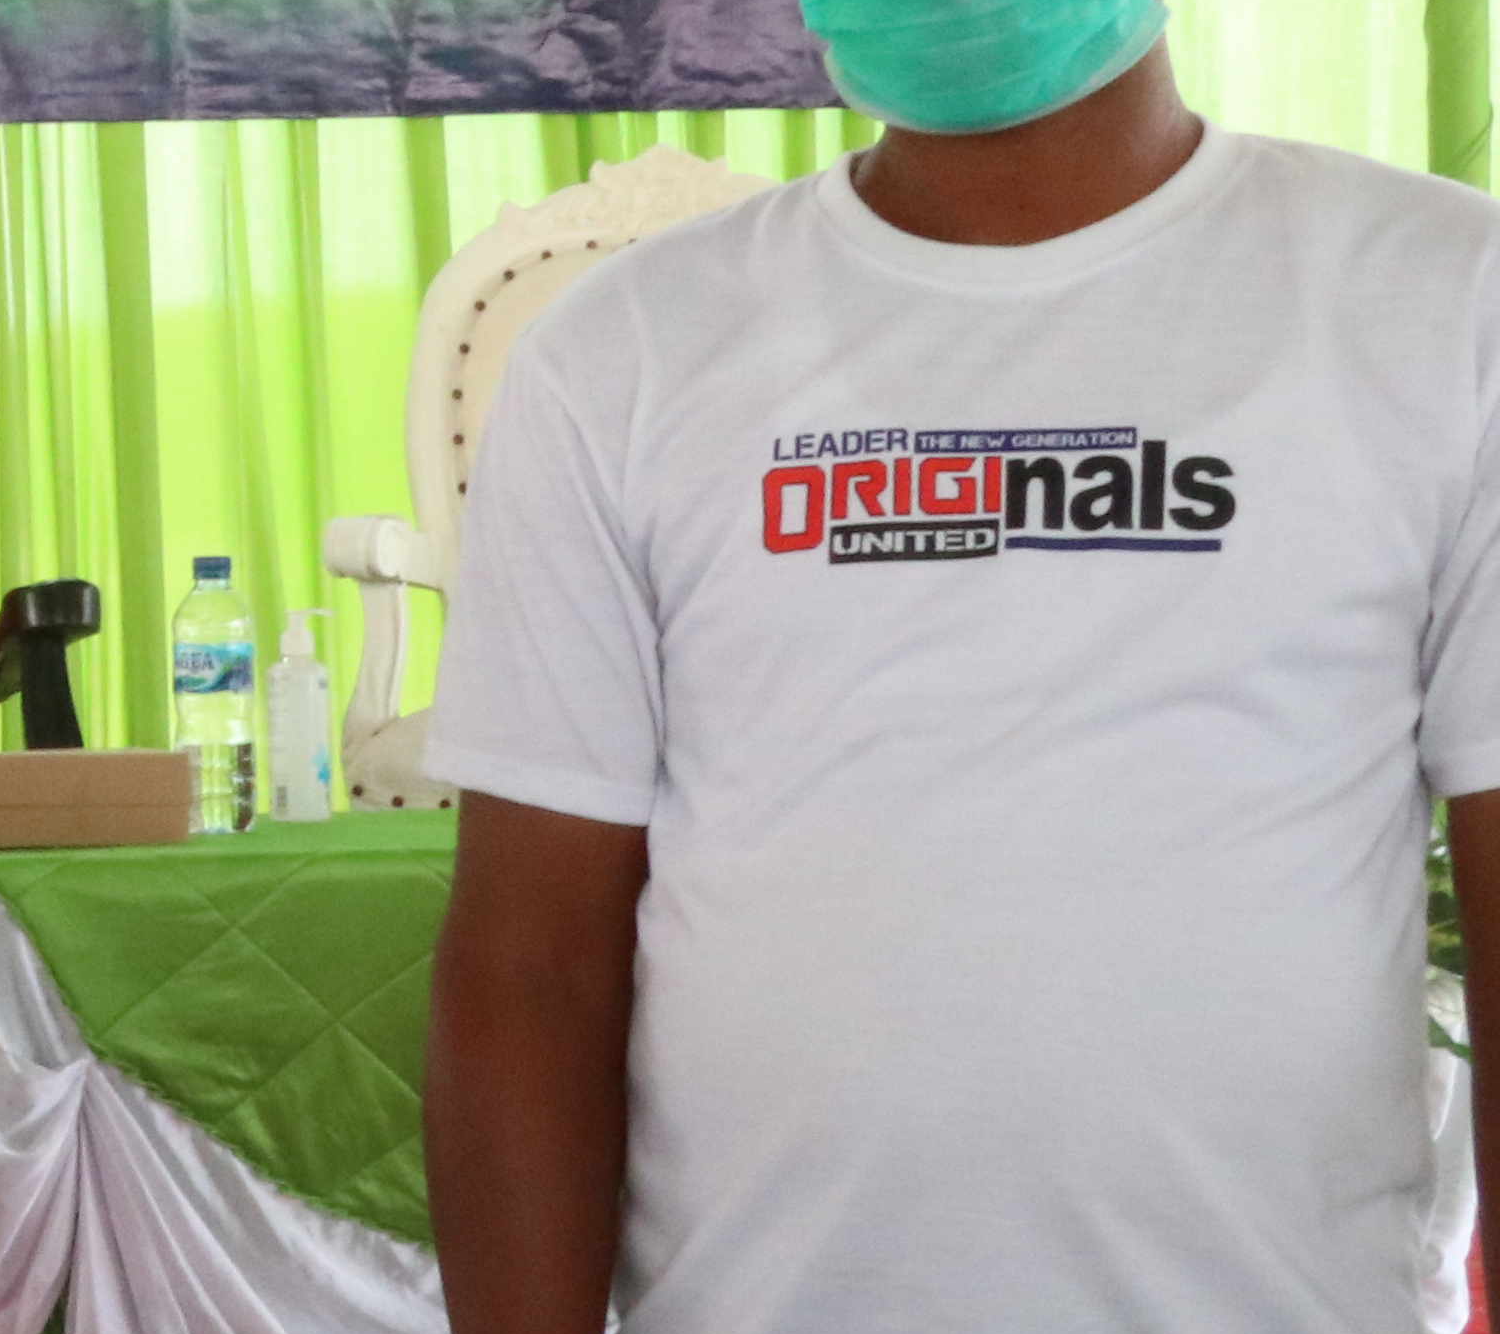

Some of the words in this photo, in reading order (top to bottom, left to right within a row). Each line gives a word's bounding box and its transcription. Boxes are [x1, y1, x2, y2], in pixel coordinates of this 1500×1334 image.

[773, 428, 909, 462] LEADER
[918, 434, 956, 450] THE
[959, 433, 1006, 450] NEW
[1010, 430, 1134, 448] GENERATION
[830, 526, 998, 557] UNITED
